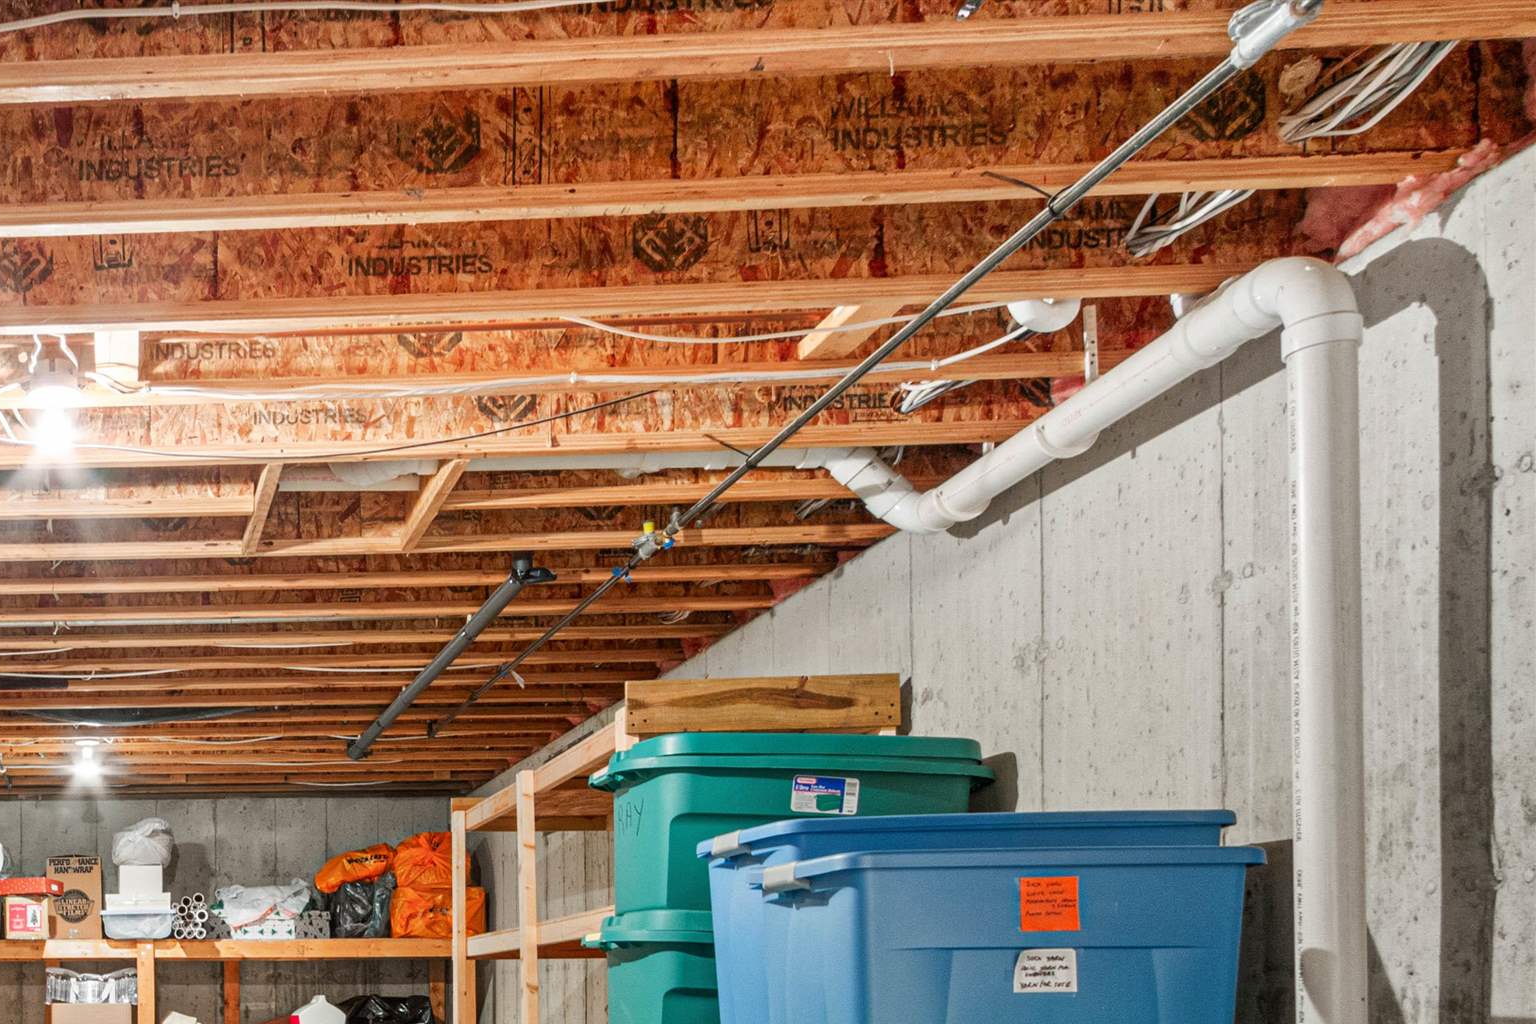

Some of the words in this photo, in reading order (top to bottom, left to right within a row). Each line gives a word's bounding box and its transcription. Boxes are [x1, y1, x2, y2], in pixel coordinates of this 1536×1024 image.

[832, 123, 1008, 150] INDUSTRIES
[78, 155, 240, 181] INDUSTRIES
[348, 253, 493, 277] INDUSTRIES
[151, 341, 276, 361] INDUSTRIES
[253, 407, 366, 425] INDUSTRIES
